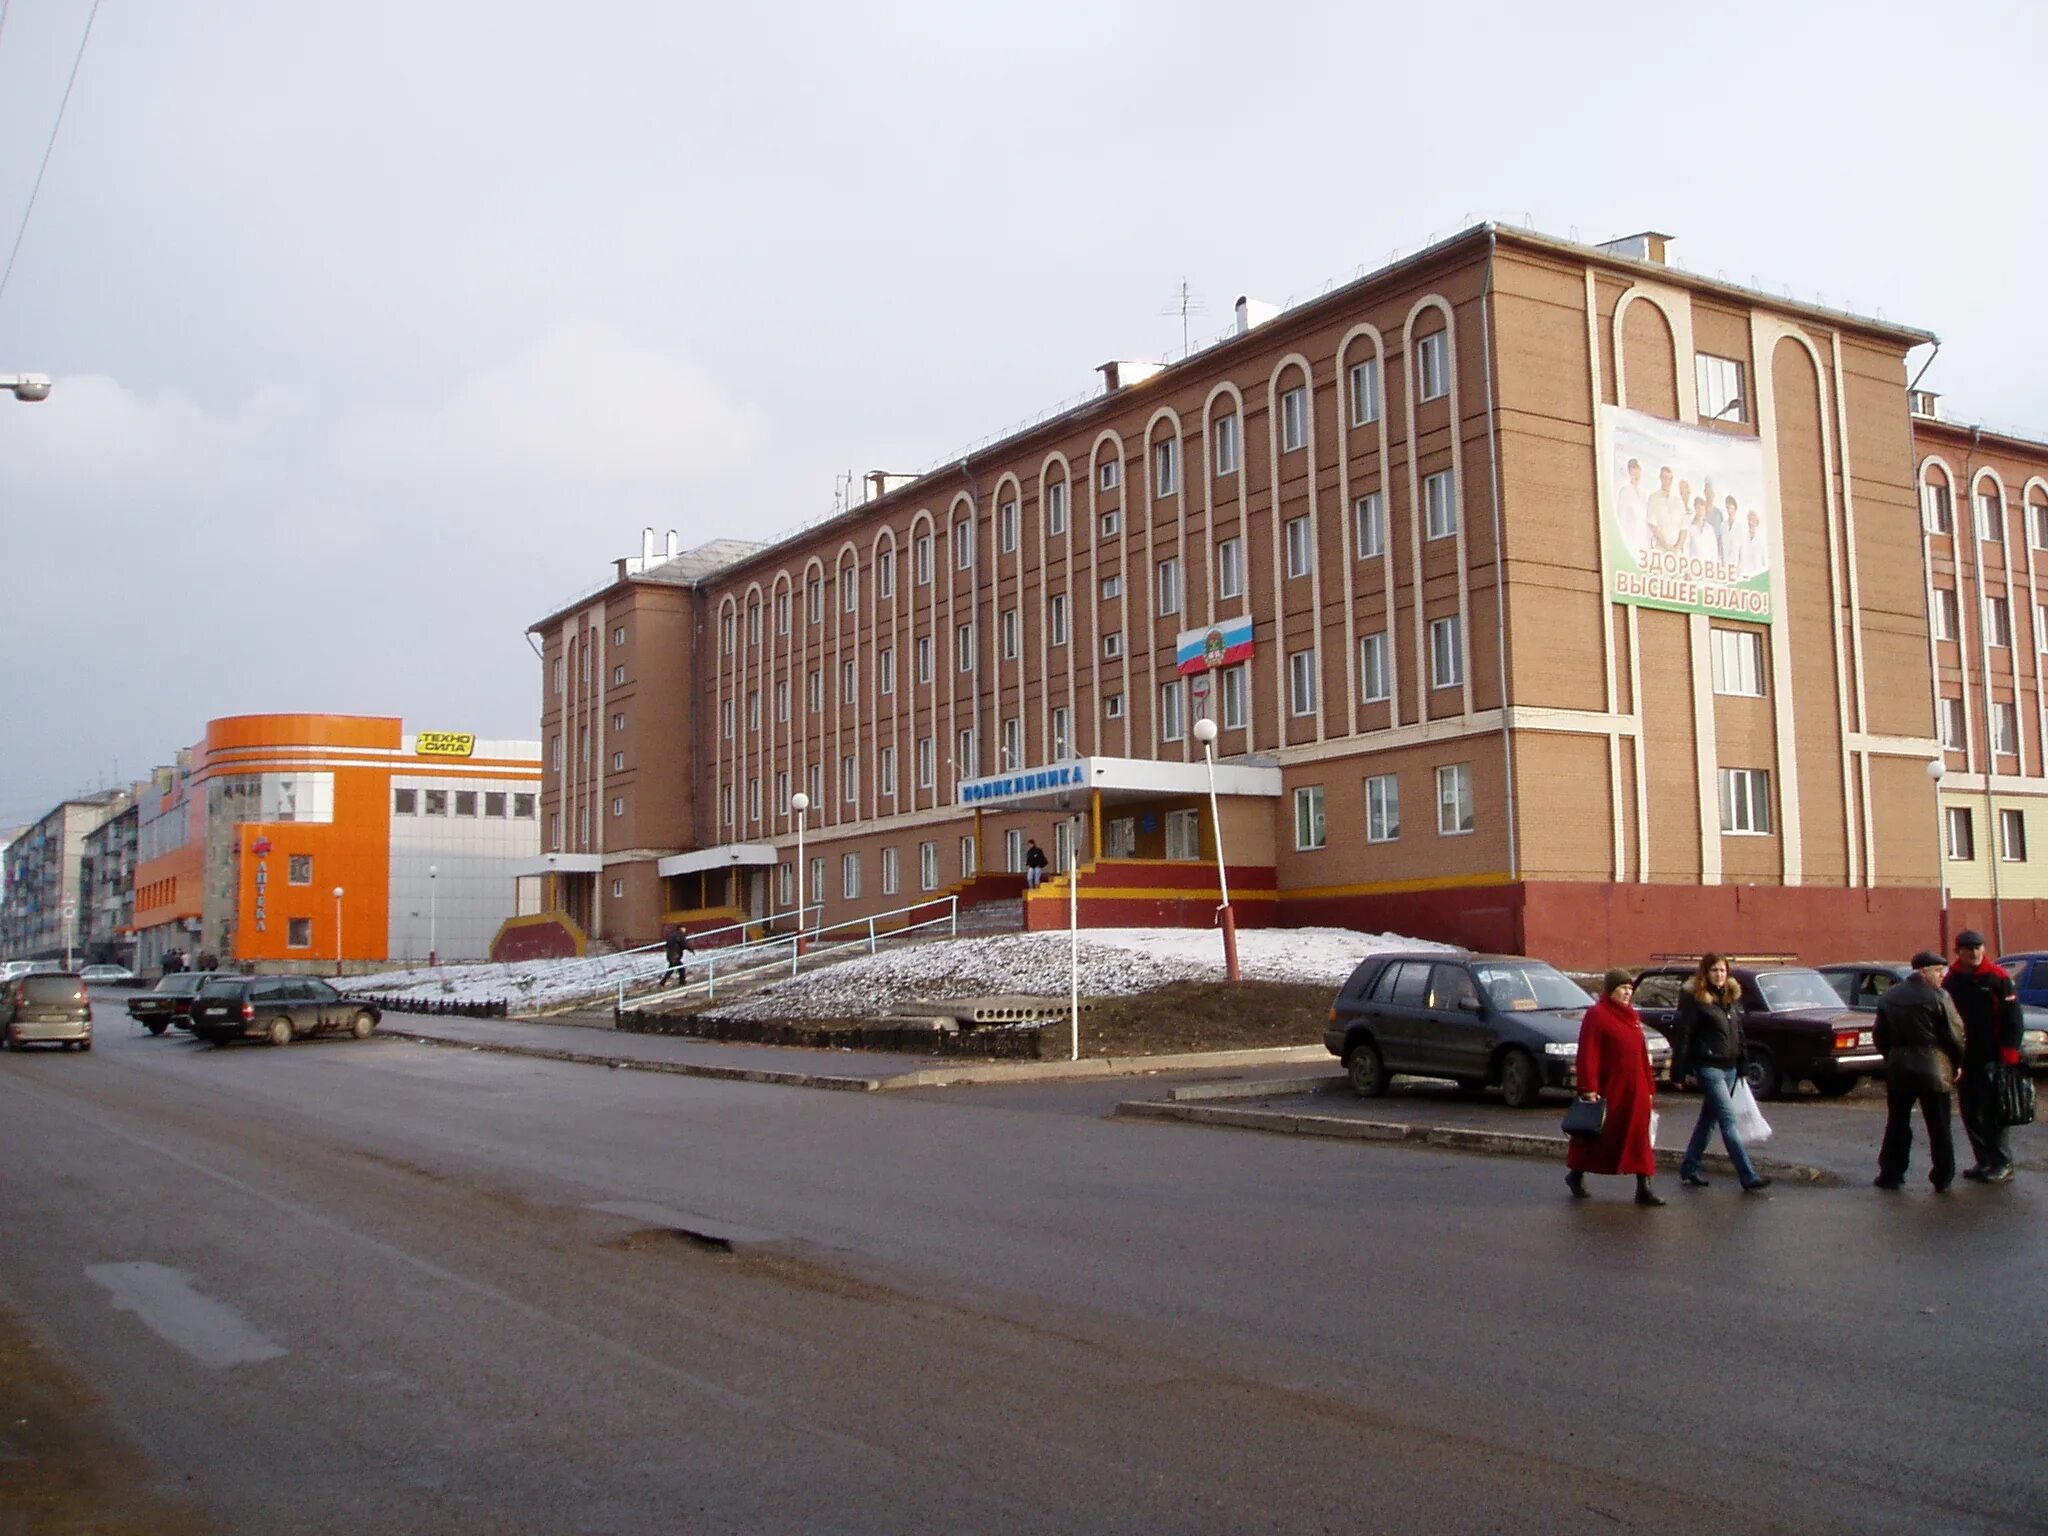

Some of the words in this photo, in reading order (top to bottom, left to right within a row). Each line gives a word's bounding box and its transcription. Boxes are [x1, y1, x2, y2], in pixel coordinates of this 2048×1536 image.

[1638, 549, 1737, 582] ЗДОРОВЬЕ
[1616, 573, 1698, 603] ВЫСШЕЕ
[1704, 586, 1769, 613] БЛАГО!
[423, 733, 470, 743] ТЕХНО
[425, 742, 465, 752] СИЛА
[963, 765, 1084, 802] ПОЛИКЛИНИКА
[256, 860, 267, 931] АПТЕКА
